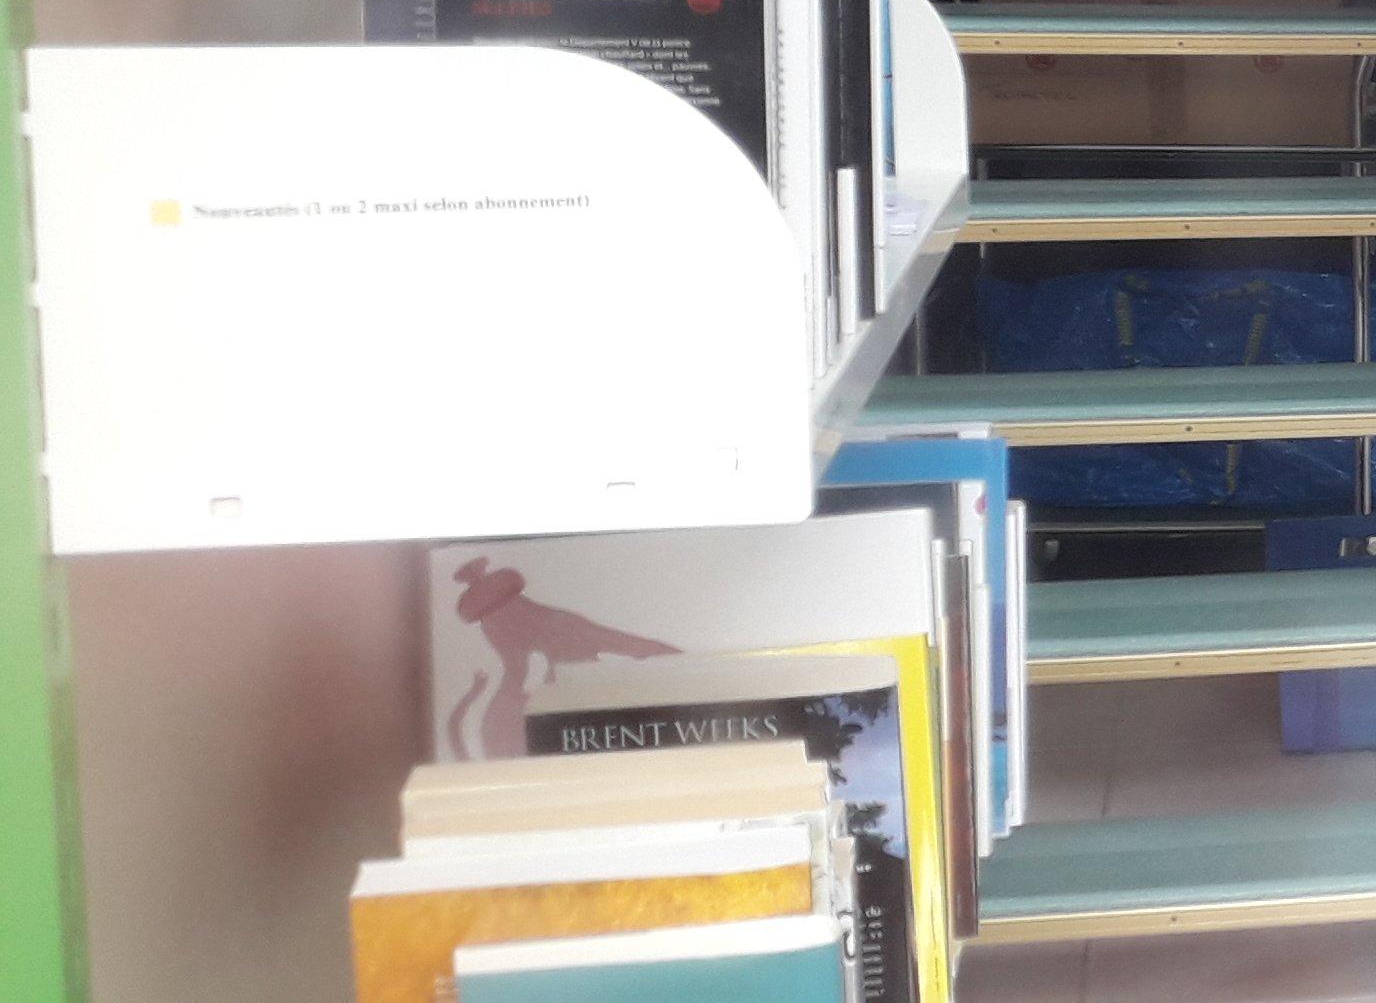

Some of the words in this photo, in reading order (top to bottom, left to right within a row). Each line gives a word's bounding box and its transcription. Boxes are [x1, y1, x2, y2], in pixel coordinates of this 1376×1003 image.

[373, 198, 418, 214] maxi
[423, 196, 469, 212] selon
[474, 194, 591, 210] abonnement)
[562, 721, 667, 752] BRENT
